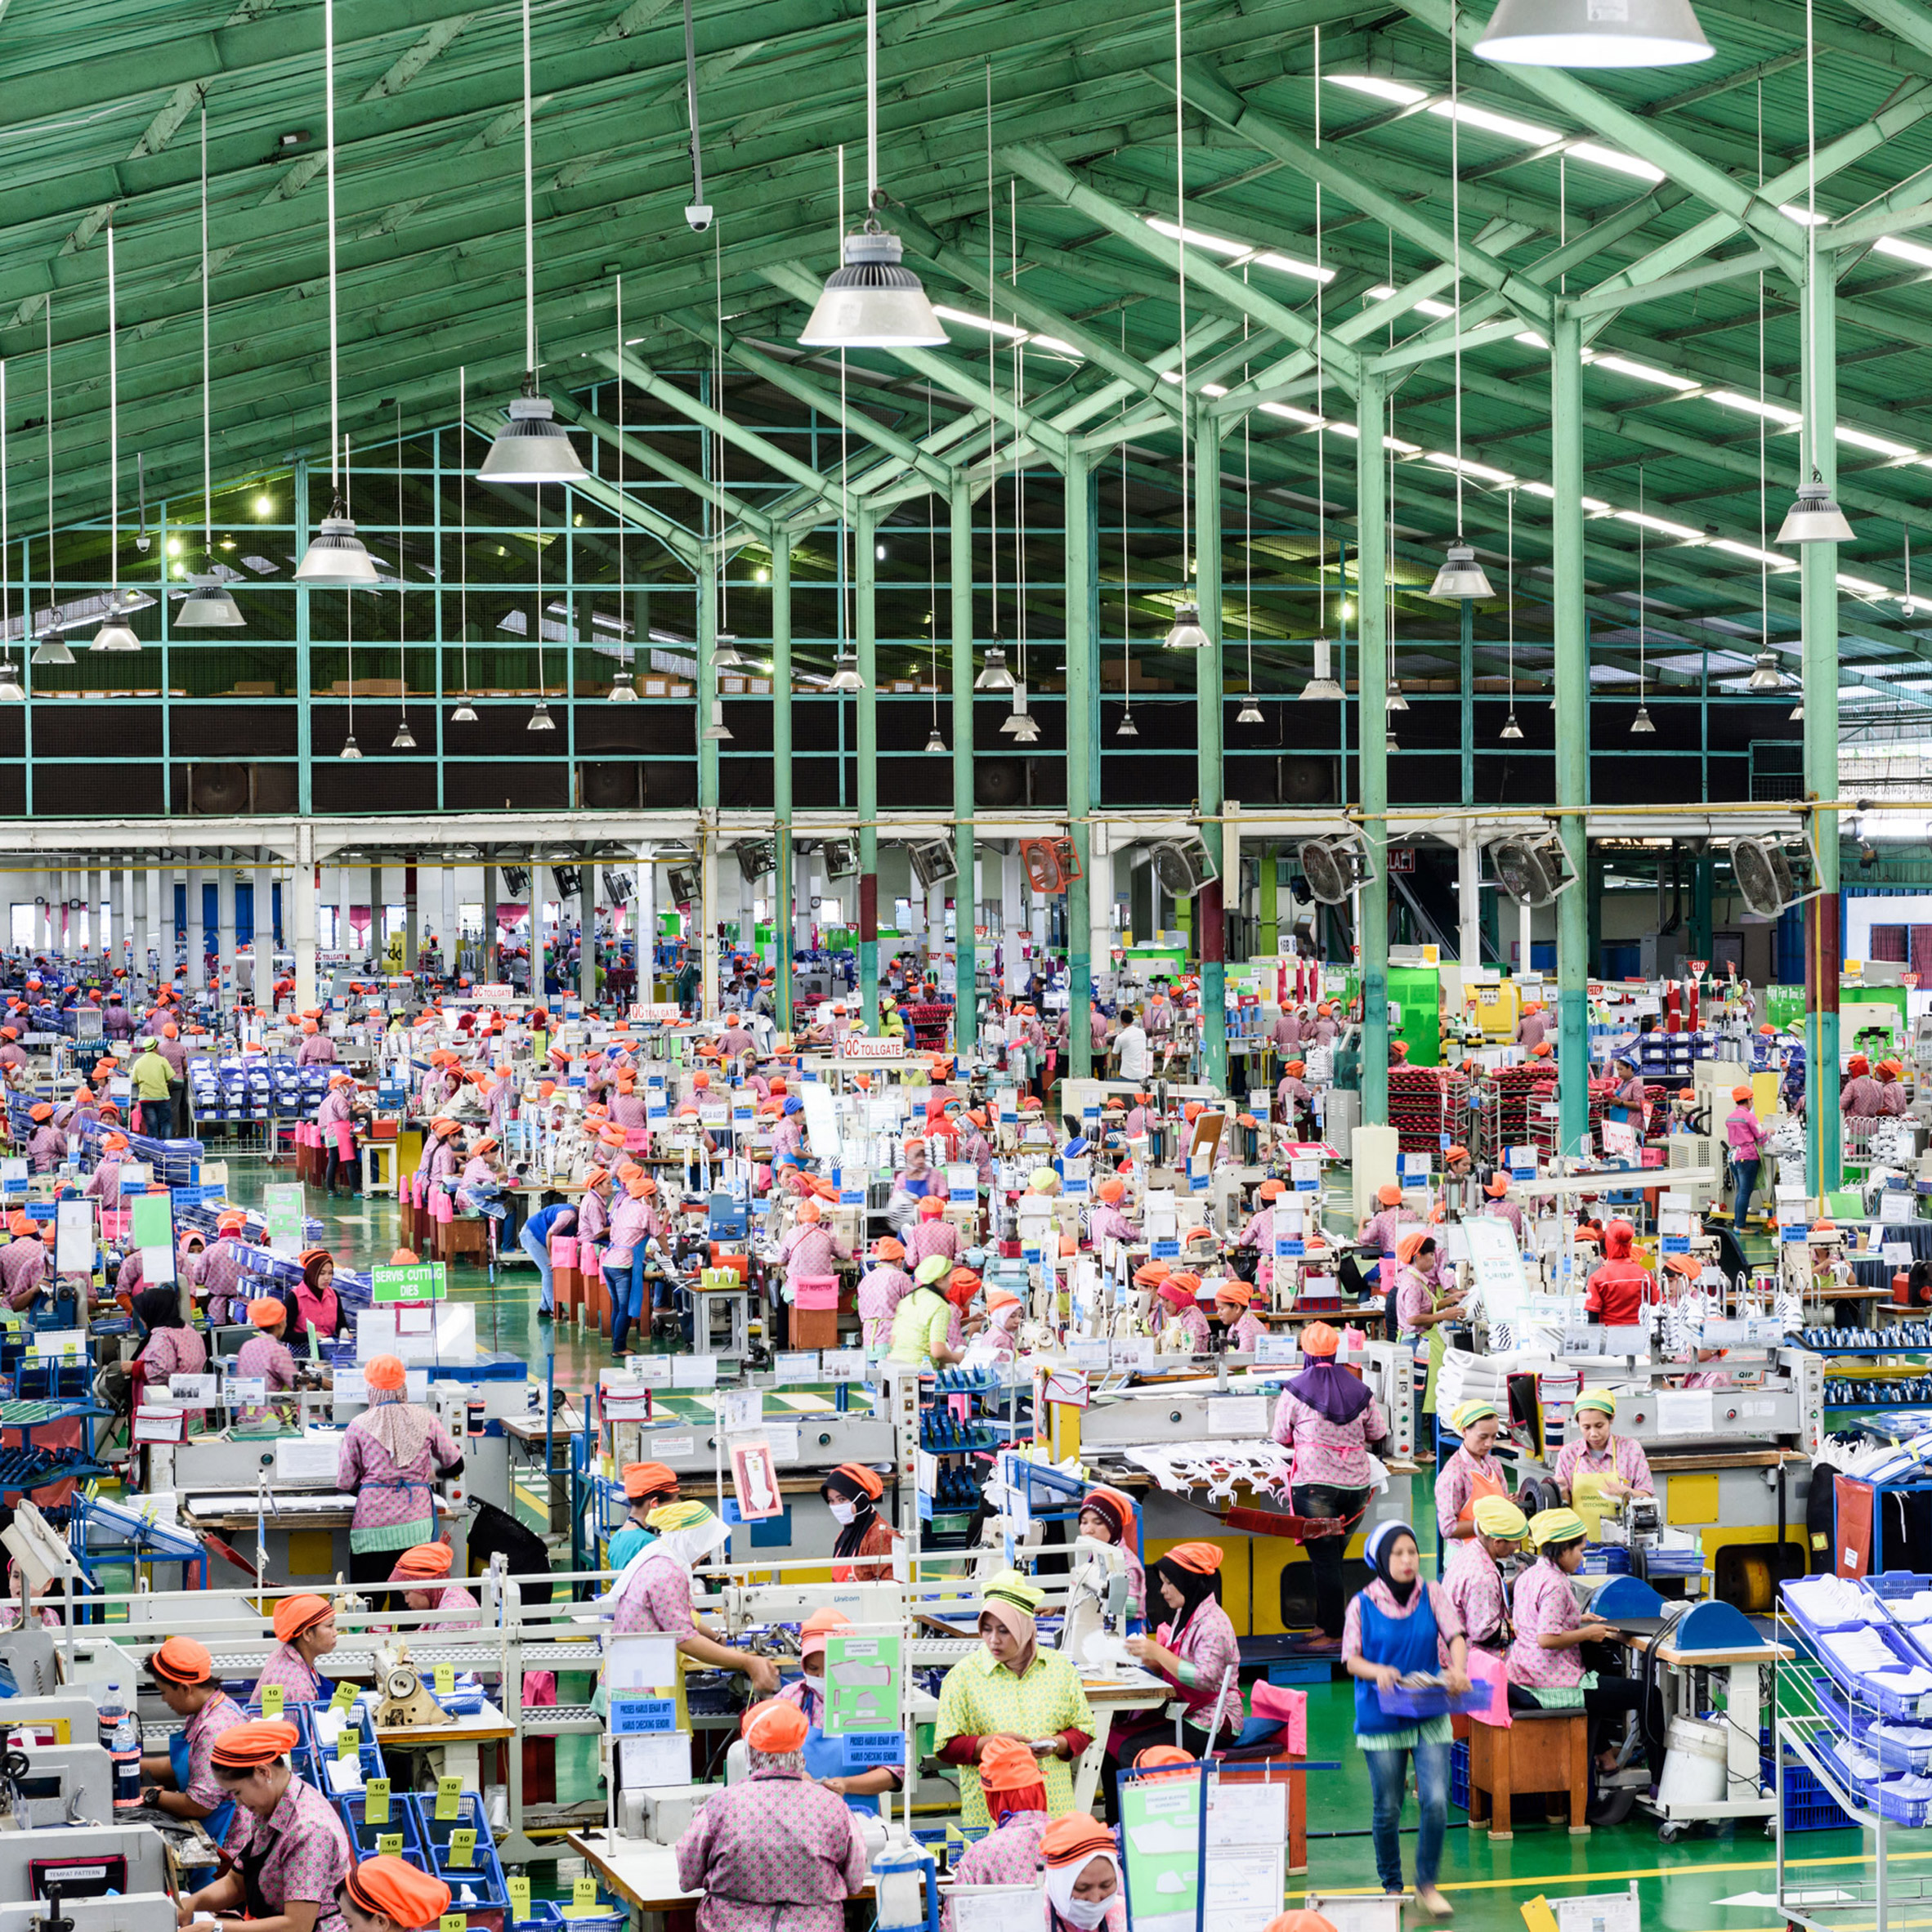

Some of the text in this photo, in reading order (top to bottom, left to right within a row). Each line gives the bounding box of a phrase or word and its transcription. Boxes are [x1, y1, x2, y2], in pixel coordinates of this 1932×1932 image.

[472, 985, 483, 997] QC
[632, 1004, 678, 1018] QC TOLLGATE
[845, 1039, 901, 1056] QC TOLLGATE
[375, 1268, 442, 1282] SERVIS CUTTING
[400, 1284, 418, 1296] DIES
[342, 1687, 353, 1695] 10
